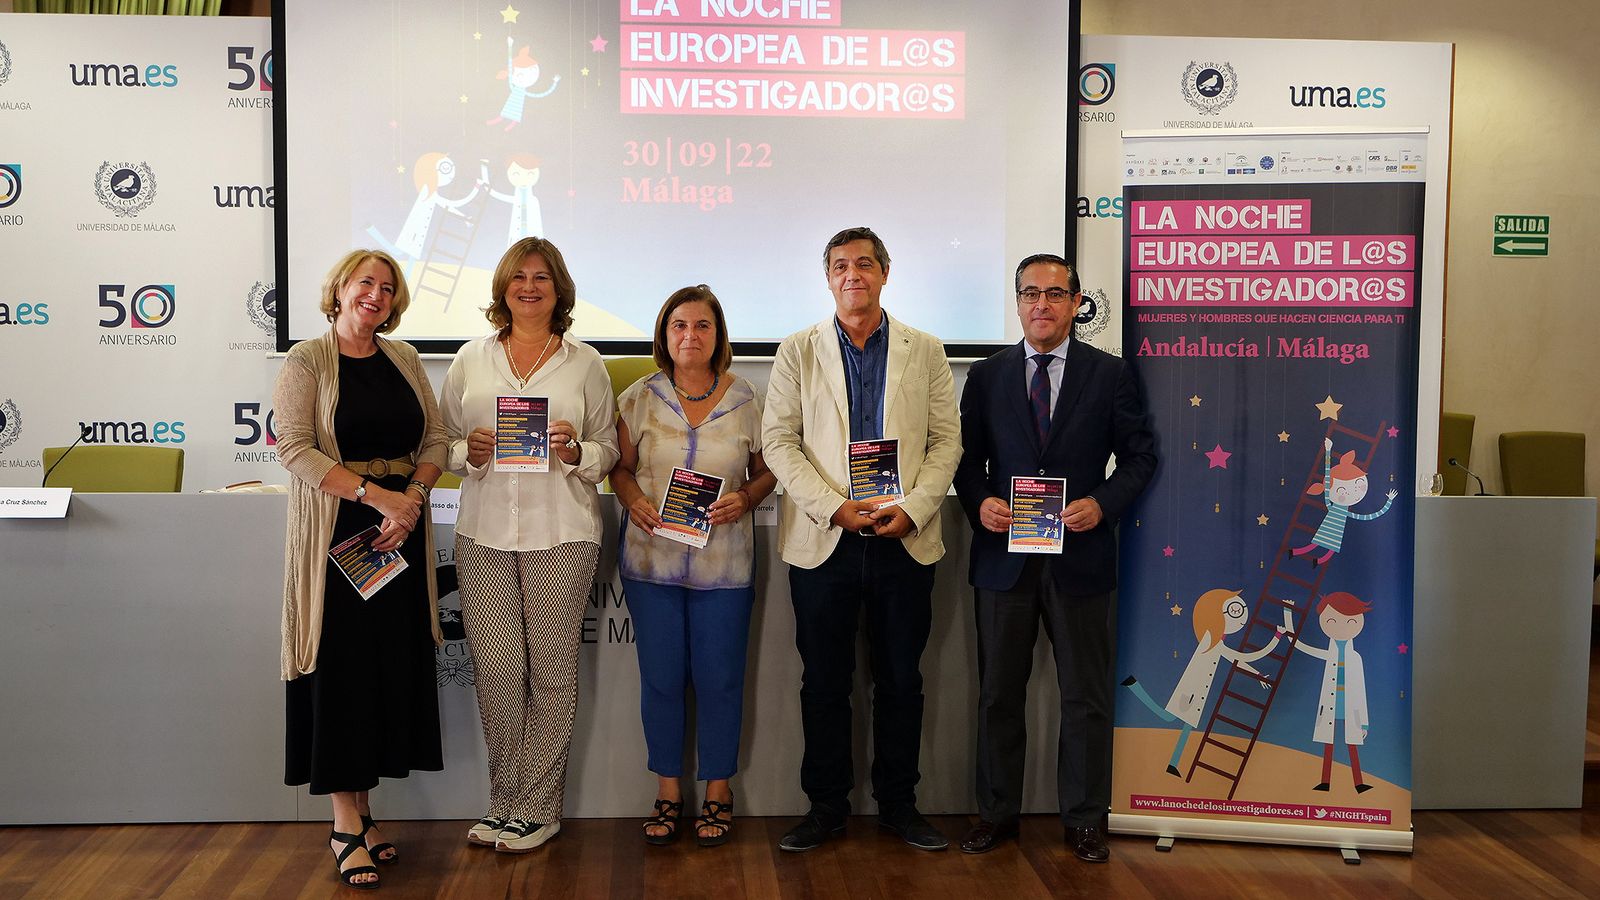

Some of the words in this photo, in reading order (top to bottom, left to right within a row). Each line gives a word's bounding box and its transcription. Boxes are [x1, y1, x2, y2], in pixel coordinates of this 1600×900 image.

[630, 0, 680, 17] LA
[701, 0, 831, 20] NOCHE
[630, 31, 806, 65] EUROPEA
[823, 36, 869, 66] DE
[881, 36, 956, 68] L@S
[69, 63, 179, 87] uma.es
[228, 46, 272, 91] 5
[1190, 62, 1231, 83] UNIVERSITAS
[630, 77, 956, 112] INVESTIGADOR@S
[1290, 85, 1386, 109] uma.es
[1164, 121, 1212, 129] UNIVERSIDAD
[1213, 121, 1223, 129] DE
[1224, 120, 1254, 129] MÁLAGA
[103, 162, 149, 184] UNIVERSITAS
[622, 177, 734, 212] Málaga
[76, 223, 130, 232] UNIVERSIDAD
[131, 224, 142, 232] DE
[143, 222, 176, 232] MÁLAGA
[1139, 206, 1179, 230] LA
[1195, 205, 1303, 229] NOCHE
[1498, 218, 1546, 232] SALIDA
[1138, 241, 1280, 266] EUROPEA
[1294, 241, 1333, 265] DE
[1342, 240, 1407, 265] L@S
[1137, 277, 1407, 302] INVESTIGADOR@S
[1138, 313, 1188, 324] MUJERES
[1189, 313, 1197, 324] Y
[1199, 313, 1253, 324] HOMBRES
[1255, 313, 1278, 325] QUE
[1279, 313, 1316, 324] HACEN
[1318, 313, 1362, 324] CIENCIA
[1364, 313, 1393, 324] PARA
[1395, 313, 1405, 324] TI
[99, 334, 177, 346] ANIVERSARIO
[229, 343, 276, 351] UNIVERSIDA
[1136, 335, 1260, 358] Andalucía
[1277, 337, 1370, 365] Málaga
[78, 421, 186, 444] uma.es
[10, 458, 42, 468] MÁLAGA
[1135, 798, 1304, 817] www.lanochedelosinvestigadores.es
[1329, 810, 1388, 822] #NIGHTspain
